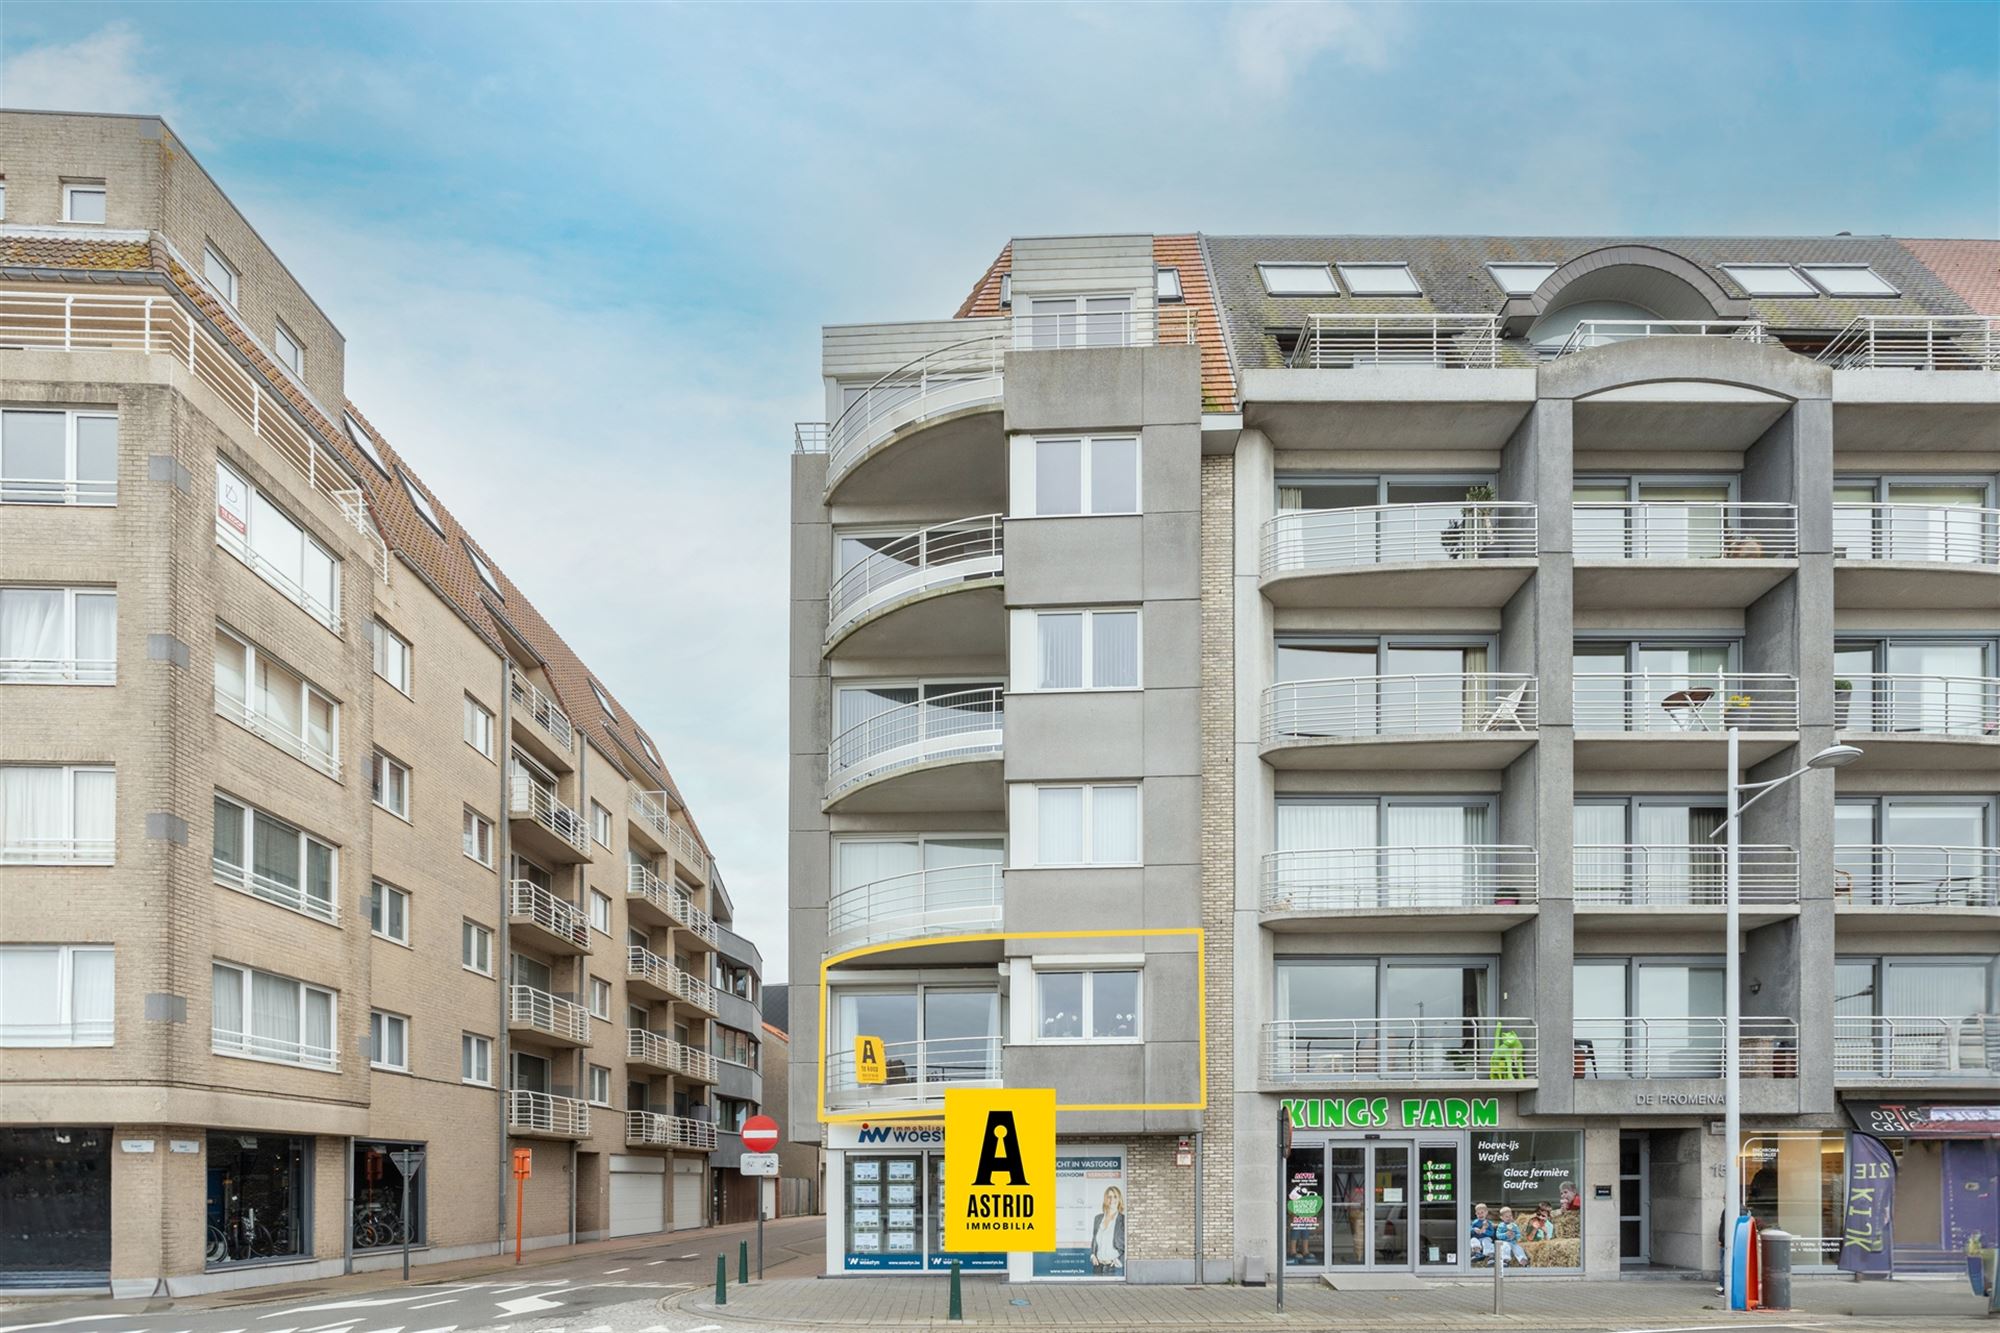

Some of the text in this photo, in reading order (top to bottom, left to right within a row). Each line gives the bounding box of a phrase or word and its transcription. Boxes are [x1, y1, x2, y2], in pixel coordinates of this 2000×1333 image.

[1636, 1094, 1741, 1105] DE PROMENA
[1281, 1098, 1499, 1128] KINGS FARM
[1478, 1141, 1519, 1151] Hoeve-ijs
[1478, 1153, 1509, 1163] Wafels
[1503, 1168, 1569, 1178] Glace fermière
[1503, 1180, 1538, 1190] Gaufres
